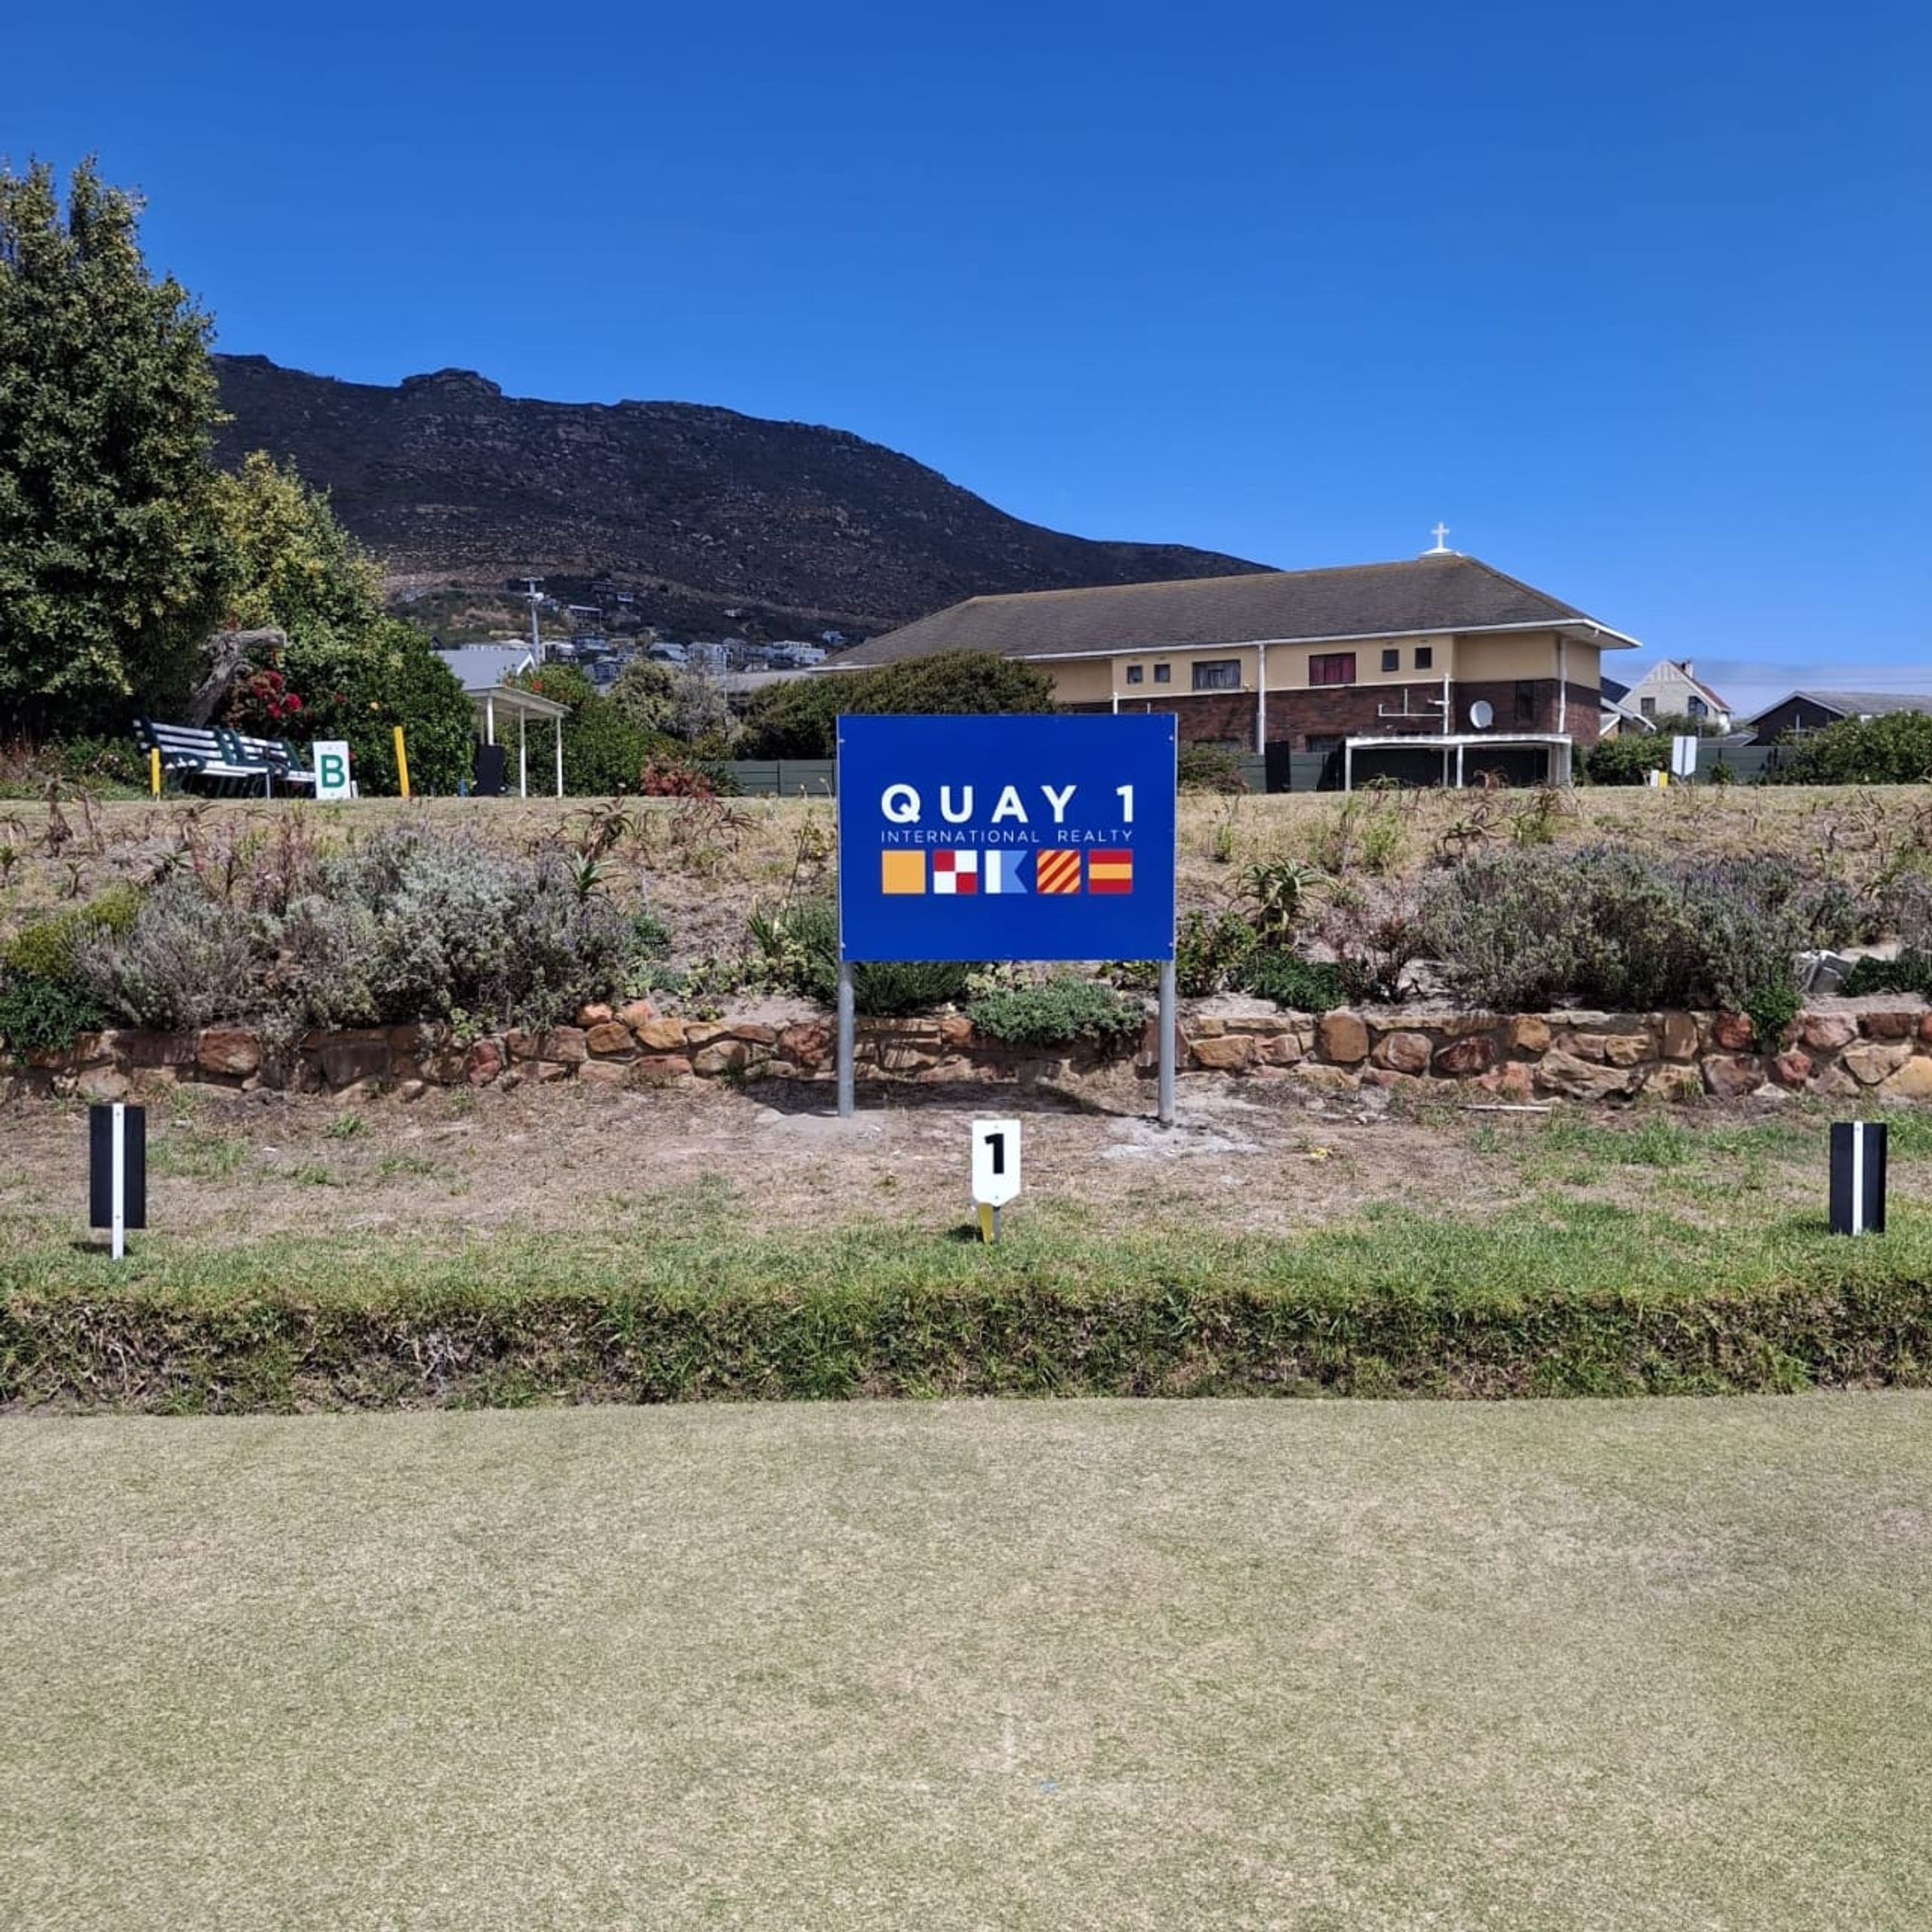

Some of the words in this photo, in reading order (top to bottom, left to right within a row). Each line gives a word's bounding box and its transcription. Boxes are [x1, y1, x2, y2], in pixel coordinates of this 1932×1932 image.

[321, 755, 345, 788] B
[881, 783, 1077, 823] QUAY
[1115, 785, 1134, 822] 1
[881, 830, 1039, 843] INTERNATIONAL
[1057, 830, 1133, 842] REALTY
[984, 1133, 1004, 1174] 1
